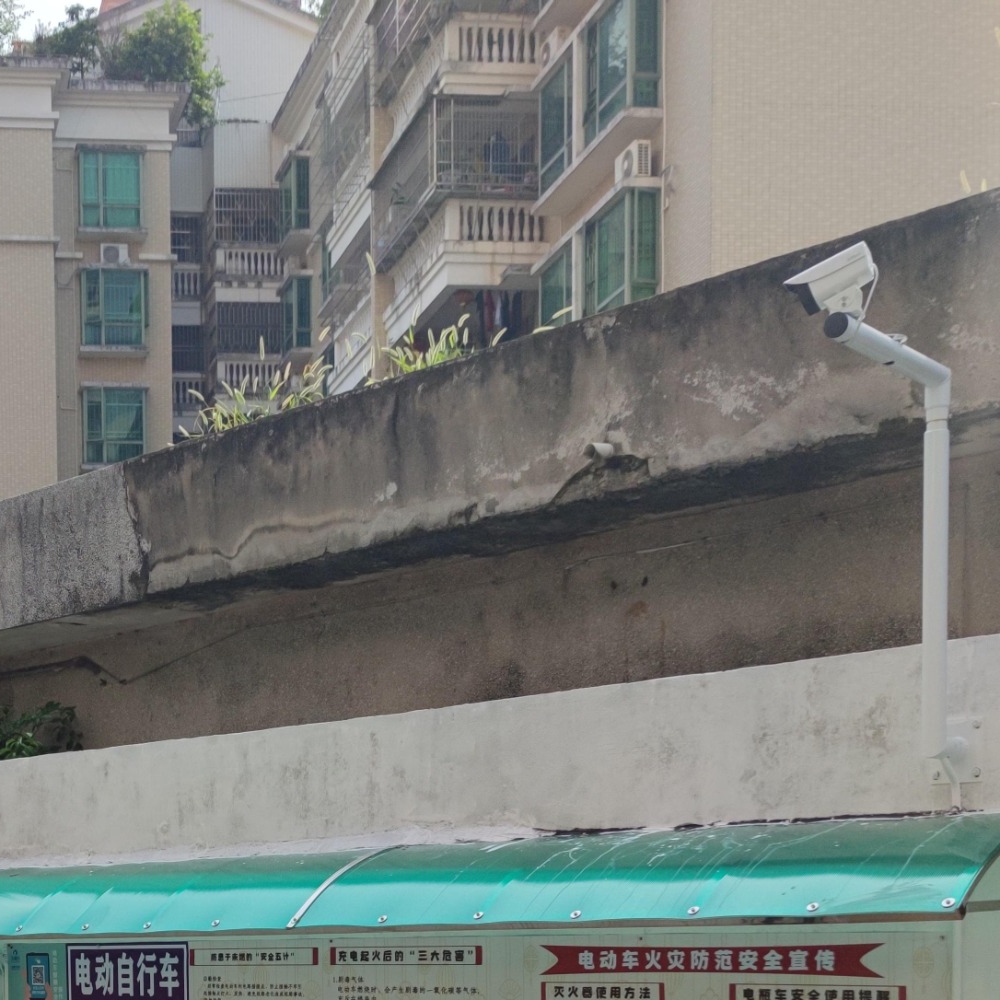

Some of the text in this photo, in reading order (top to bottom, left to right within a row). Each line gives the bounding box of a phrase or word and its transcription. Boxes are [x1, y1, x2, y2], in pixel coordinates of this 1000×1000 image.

[577, 949, 836, 972] 电动车火灾防范安全宣传
[75, 951, 180, 998] 电动自行车
[553, 985, 652, 1000] 灭火器使用方法
